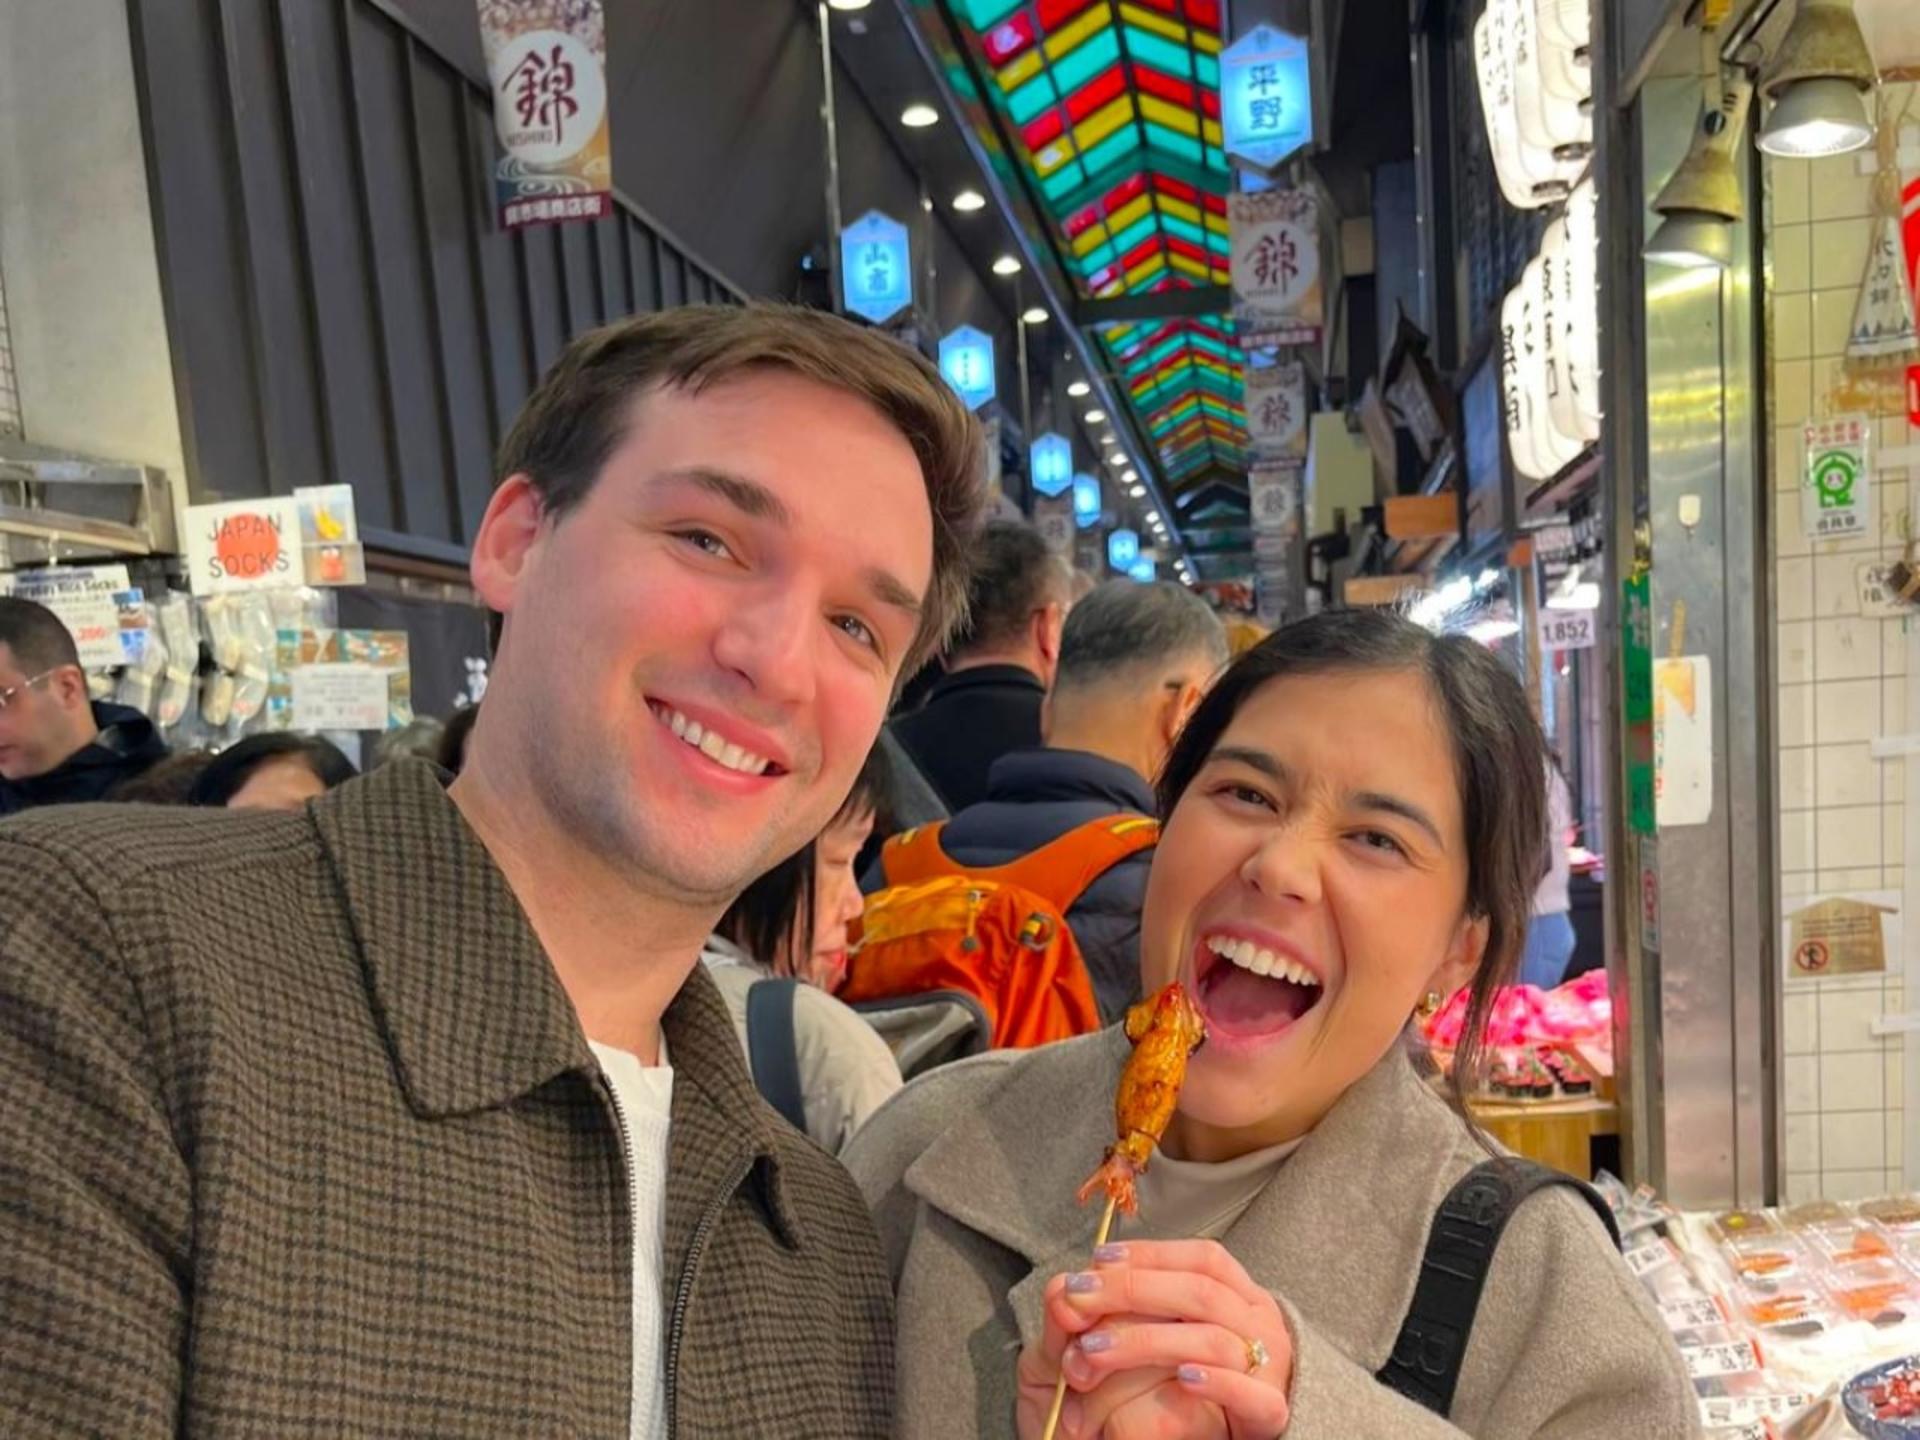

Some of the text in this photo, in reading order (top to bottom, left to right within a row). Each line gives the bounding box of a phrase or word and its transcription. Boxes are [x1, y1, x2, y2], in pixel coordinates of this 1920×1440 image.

[502, 45, 579, 146] 錦
[1248, 64, 1282, 130] 平野
[1244, 229, 1299, 297] 錦
[208, 512, 283, 542] JAPAN
[208, 551, 290, 579] SOCKS
